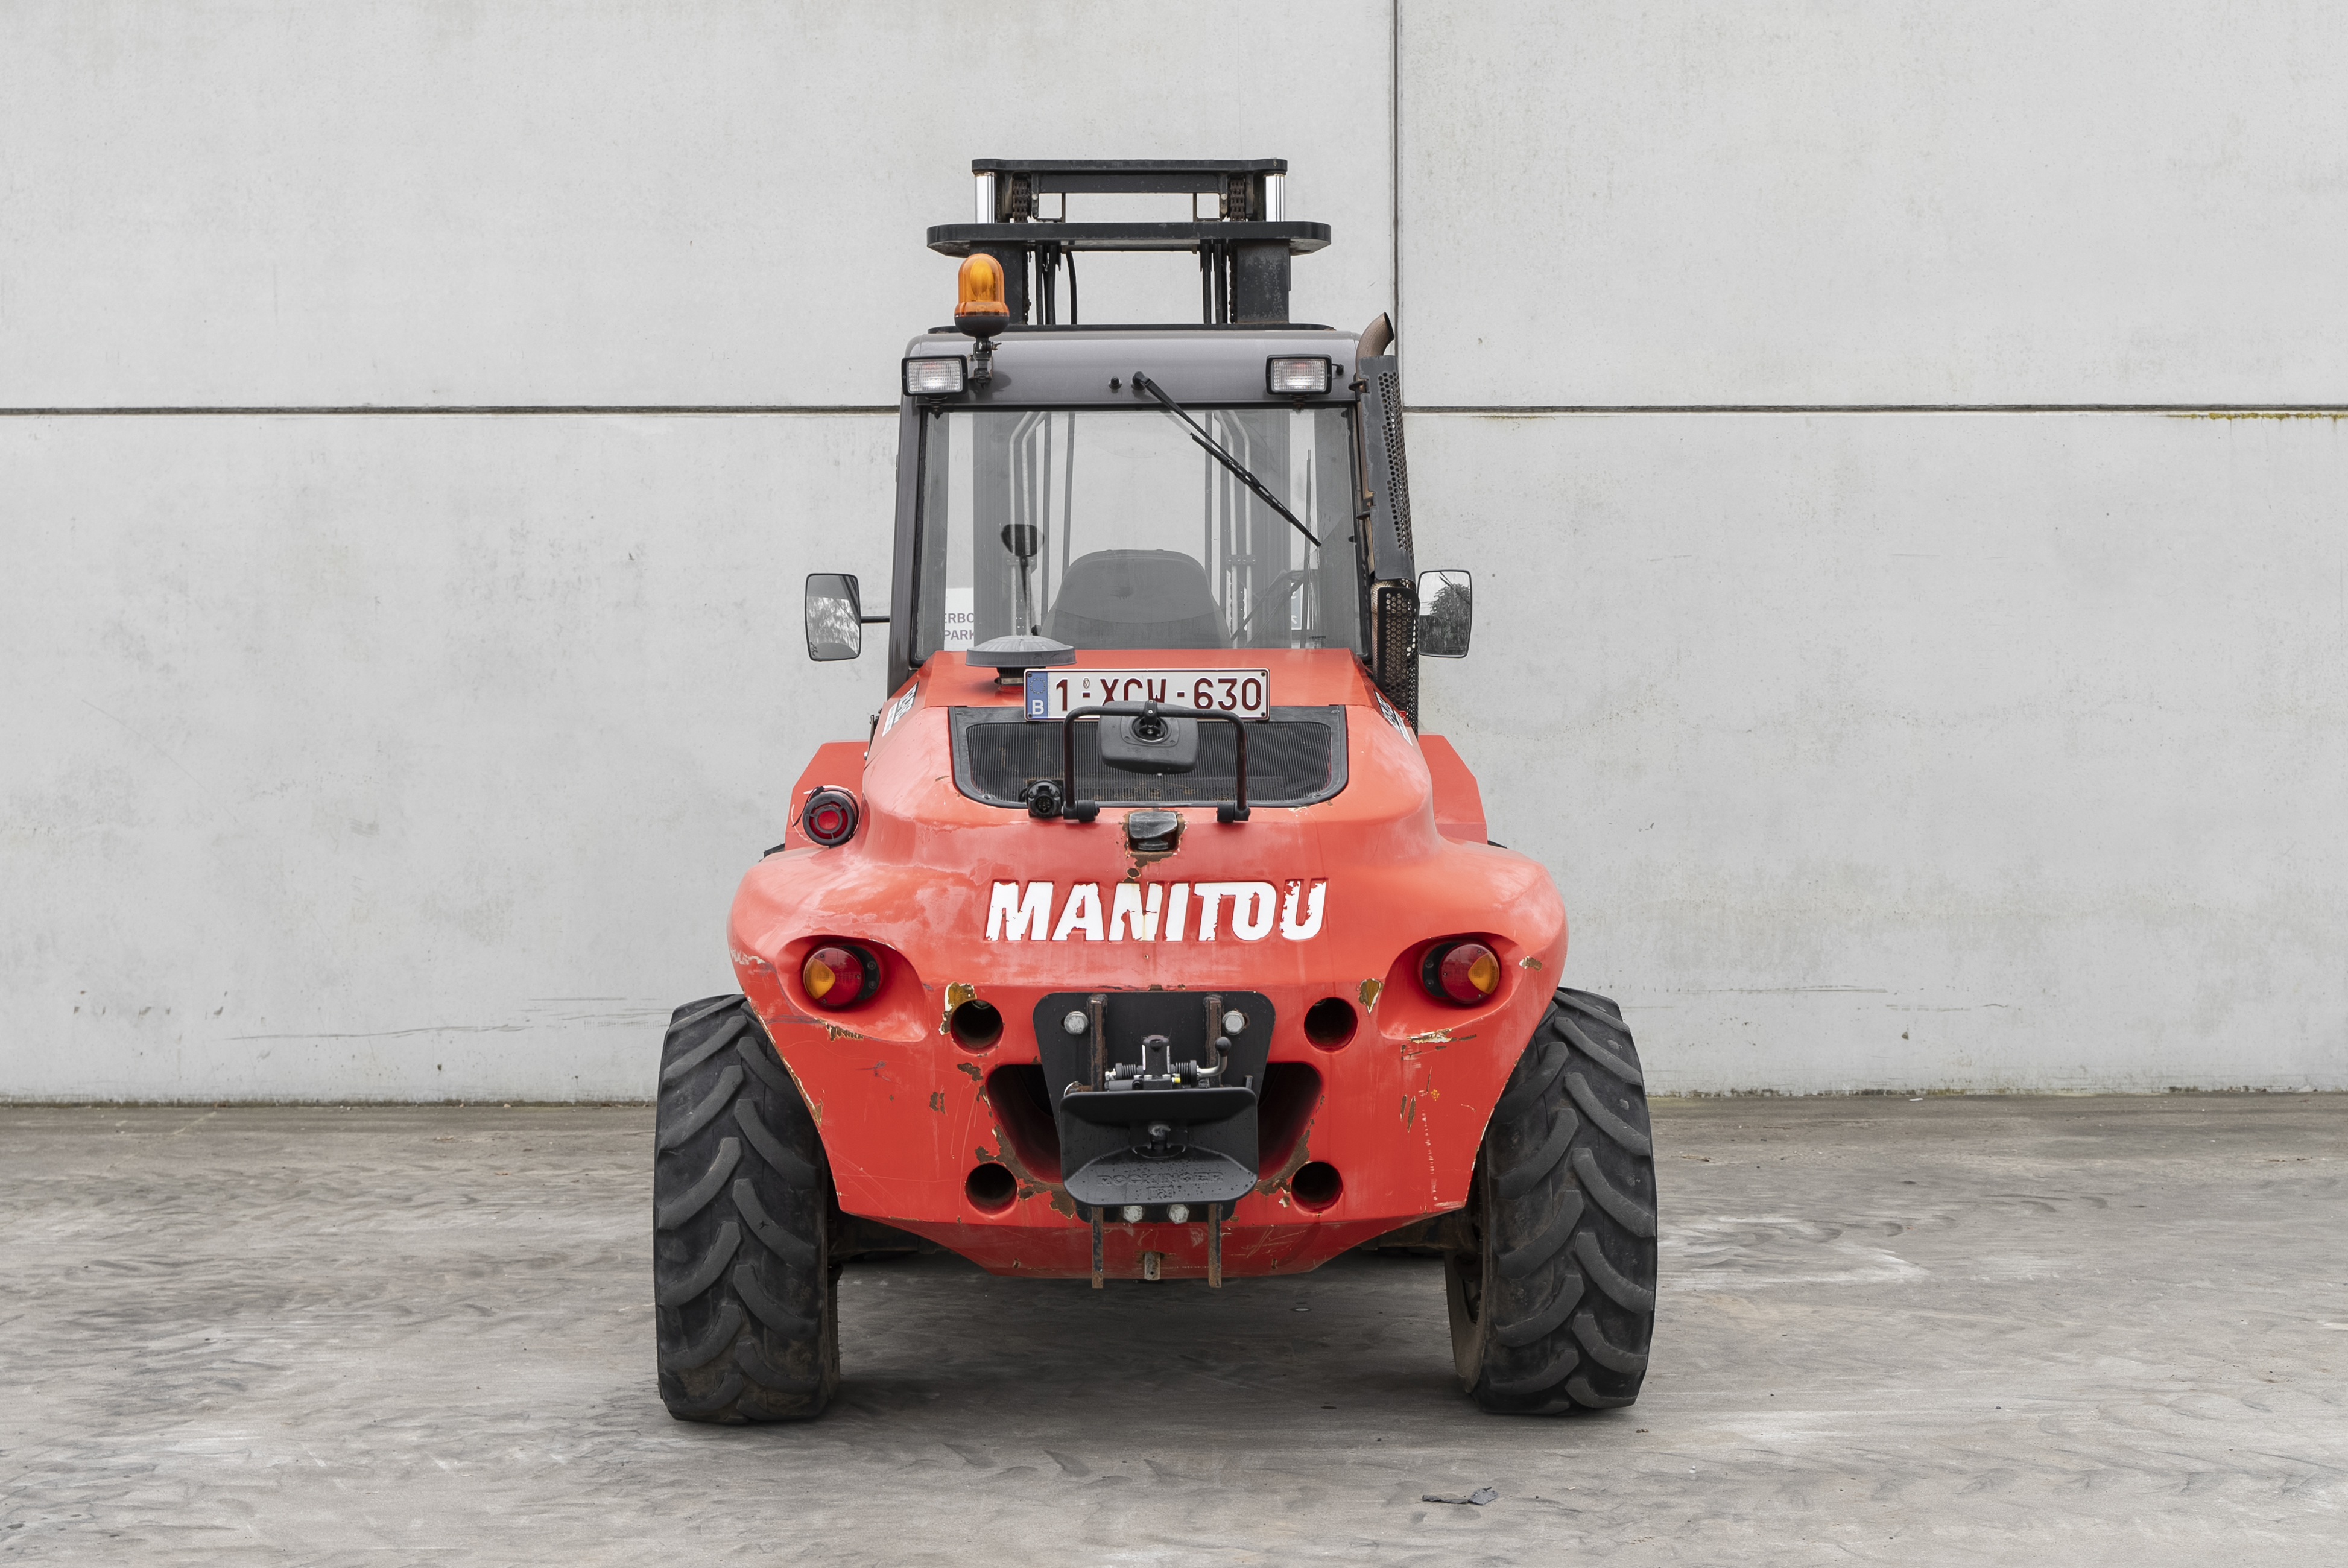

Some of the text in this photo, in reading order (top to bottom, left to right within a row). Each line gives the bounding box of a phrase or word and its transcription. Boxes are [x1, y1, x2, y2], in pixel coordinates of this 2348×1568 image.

[1032, 700, 1044, 715] B
[984, 878, 1327, 942] MANITOU
[1096, 1171, 1224, 1186] ROCKINGER
